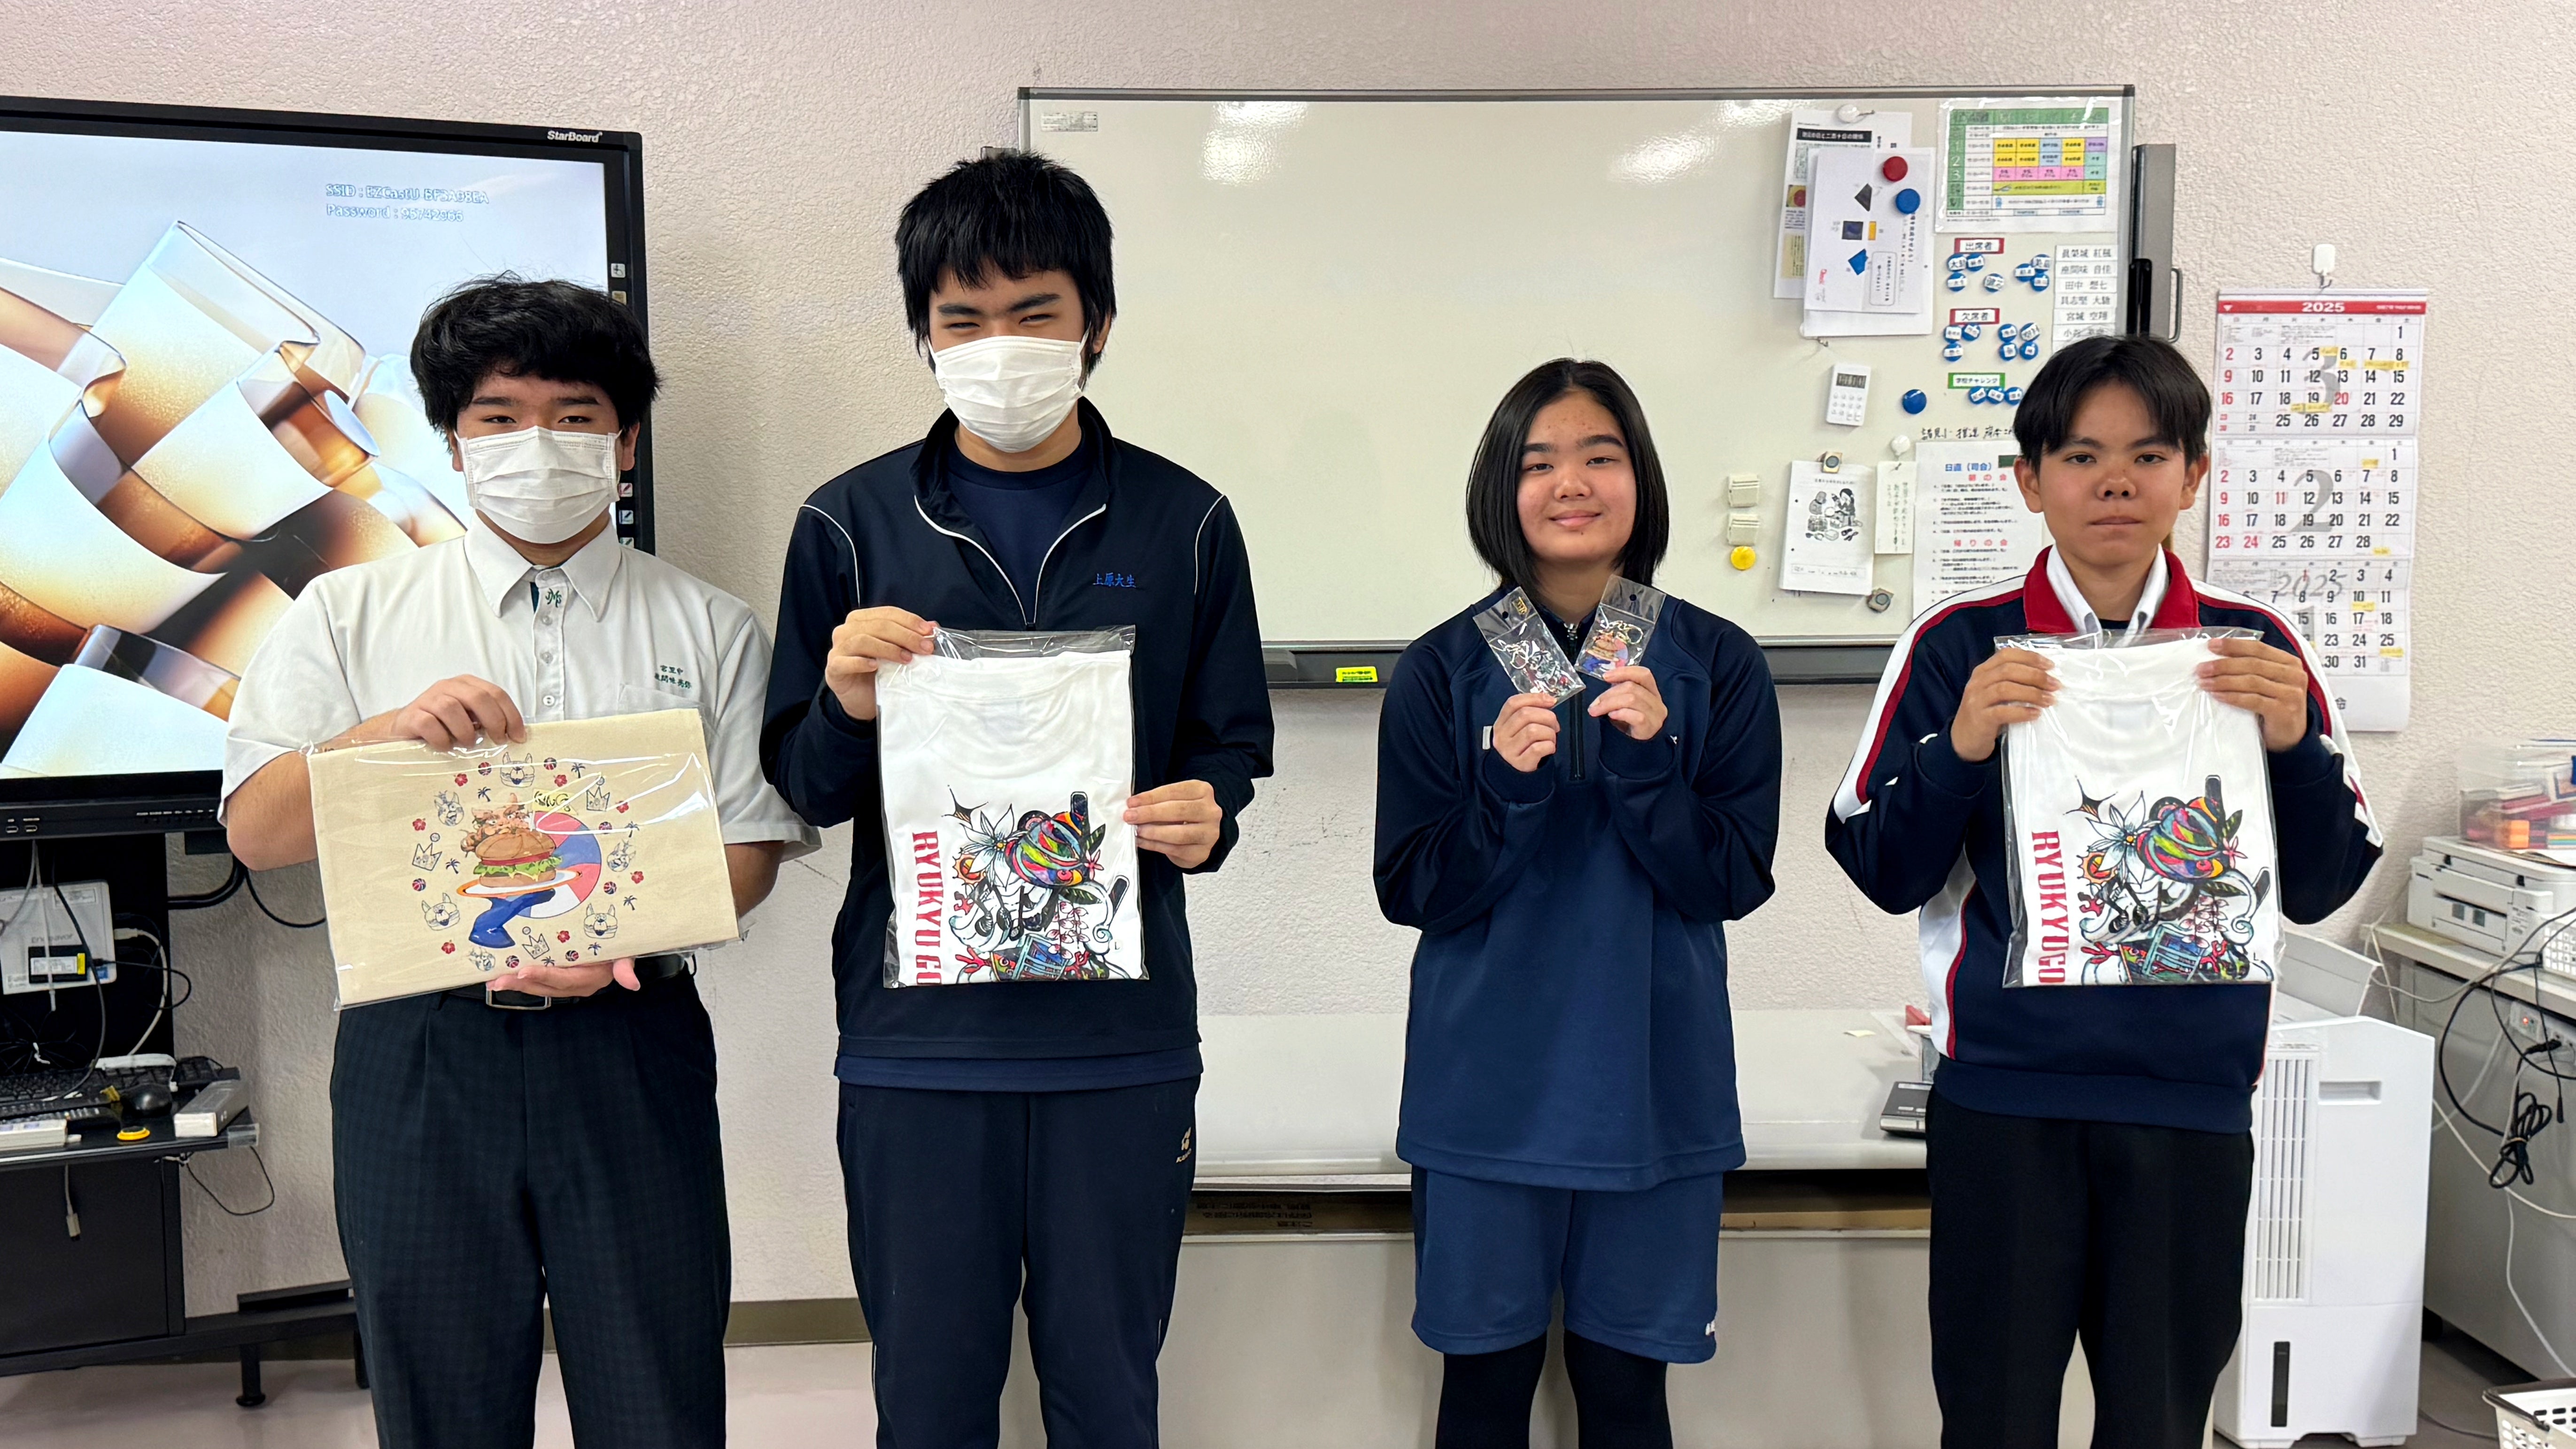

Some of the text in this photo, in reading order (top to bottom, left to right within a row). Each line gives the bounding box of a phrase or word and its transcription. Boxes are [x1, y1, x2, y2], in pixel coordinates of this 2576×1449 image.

[547, 130, 603, 143] StarBoard
[325, 184, 356, 197] SSID
[326, 204, 391, 219] Password
[1965, 242, 1992, 250] 出席者
[2065, 281, 2083, 290] 田中
[2302, 303, 2344, 312] 2025
[1962, 312, 1988, 321] 欠席者
[2066, 312, 2084, 321] 宮城
[2398, 326, 2402, 339] 1
[2226, 348, 2233, 360] 2
[2255, 347, 2262, 360] 3
[2283, 347, 2290, 360] 4
[2312, 347, 2320, 360] 5
[2340, 347, 2347, 360] 6
[2368, 348, 2375, 360] 7
[2396, 348, 2403, 361] 8
[2225, 370, 2404, 383] 9 10 11 12 13 14 15
[2222, 392, 2405, 405] 16 17 18 19 20 21 22
[2276, 414, 2290, 427] 25
[2304, 413, 2319, 427] 26
[2332, 414, 2347, 427] 27
[2360, 414, 2375, 427] 28
[2389, 414, 2404, 427] 29
[2392, 448, 2396, 460] 1
[2221, 470, 2398, 483] 2 3 4 5 6 7 8
[2221, 492, 2399, 504] 9 10 11 12 13 14 15
[2218, 513, 2399, 526] 16 17 18 19 20 21 22
[2216, 535, 2370, 548] 23 24 25 26 27 28
[1092, 572, 1137, 588] 上原大生
[2329, 569, 2337, 582] 2
[2357, 569, 2365, 581] 3
[2384, 569, 2392, 581] 4
[2271, 590, 2390, 603] 7 8 9 10 11
[2297, 612, 2392, 625] 15 16 17 18
[2325, 633, 2394, 646] 23 24 25
[2324, 655, 2366, 668] 30 31
[912, 830, 944, 948] RYUKYU
[1114, 941, 1121, 950] L
[2253, 952, 2259, 961] L
